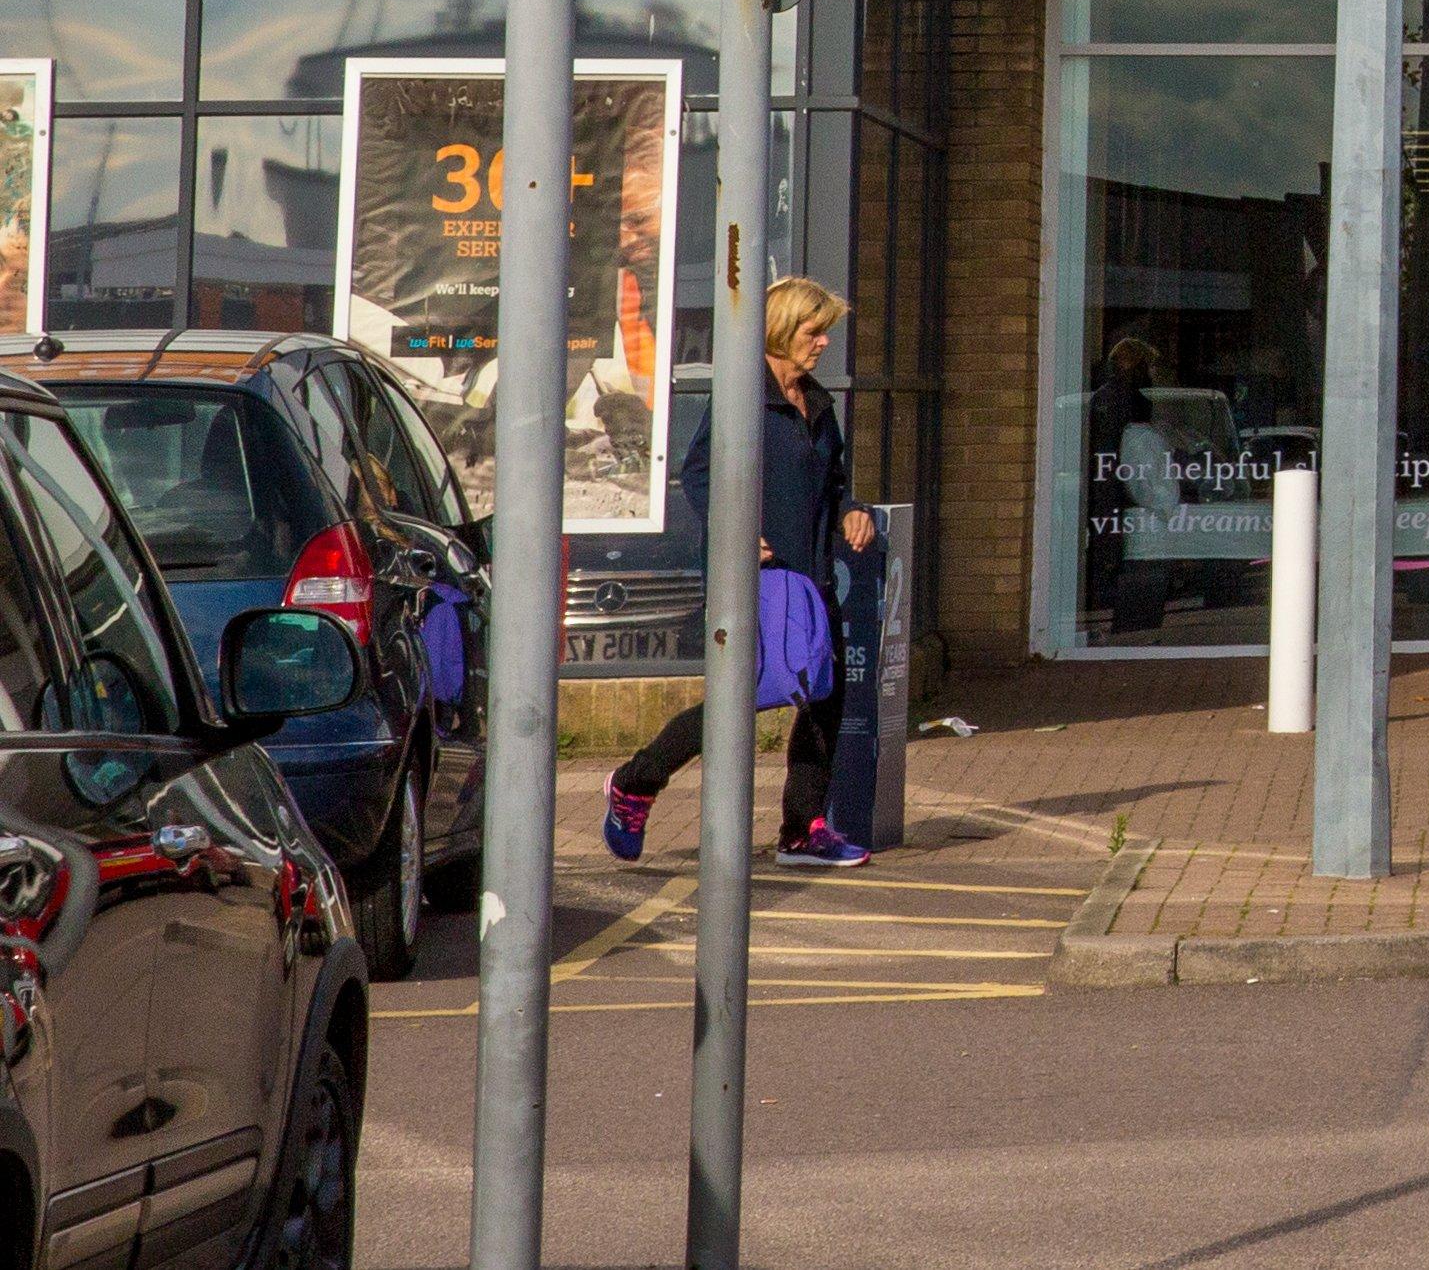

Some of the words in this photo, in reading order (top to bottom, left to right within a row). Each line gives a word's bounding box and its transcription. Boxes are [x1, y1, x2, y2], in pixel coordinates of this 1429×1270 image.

[443, 220, 504, 237] EXPE
[456, 240, 502, 258] SER
[435, 283, 467, 296] We'll
[469, 282, 500, 299] keep
[455, 335, 498, 349] weSer
[1094, 452, 1151, 482] For
[1163, 450, 1281, 491] helpful
[1090, 507, 1159, 535] visit
[1167, 503, 1273, 533] dreams
